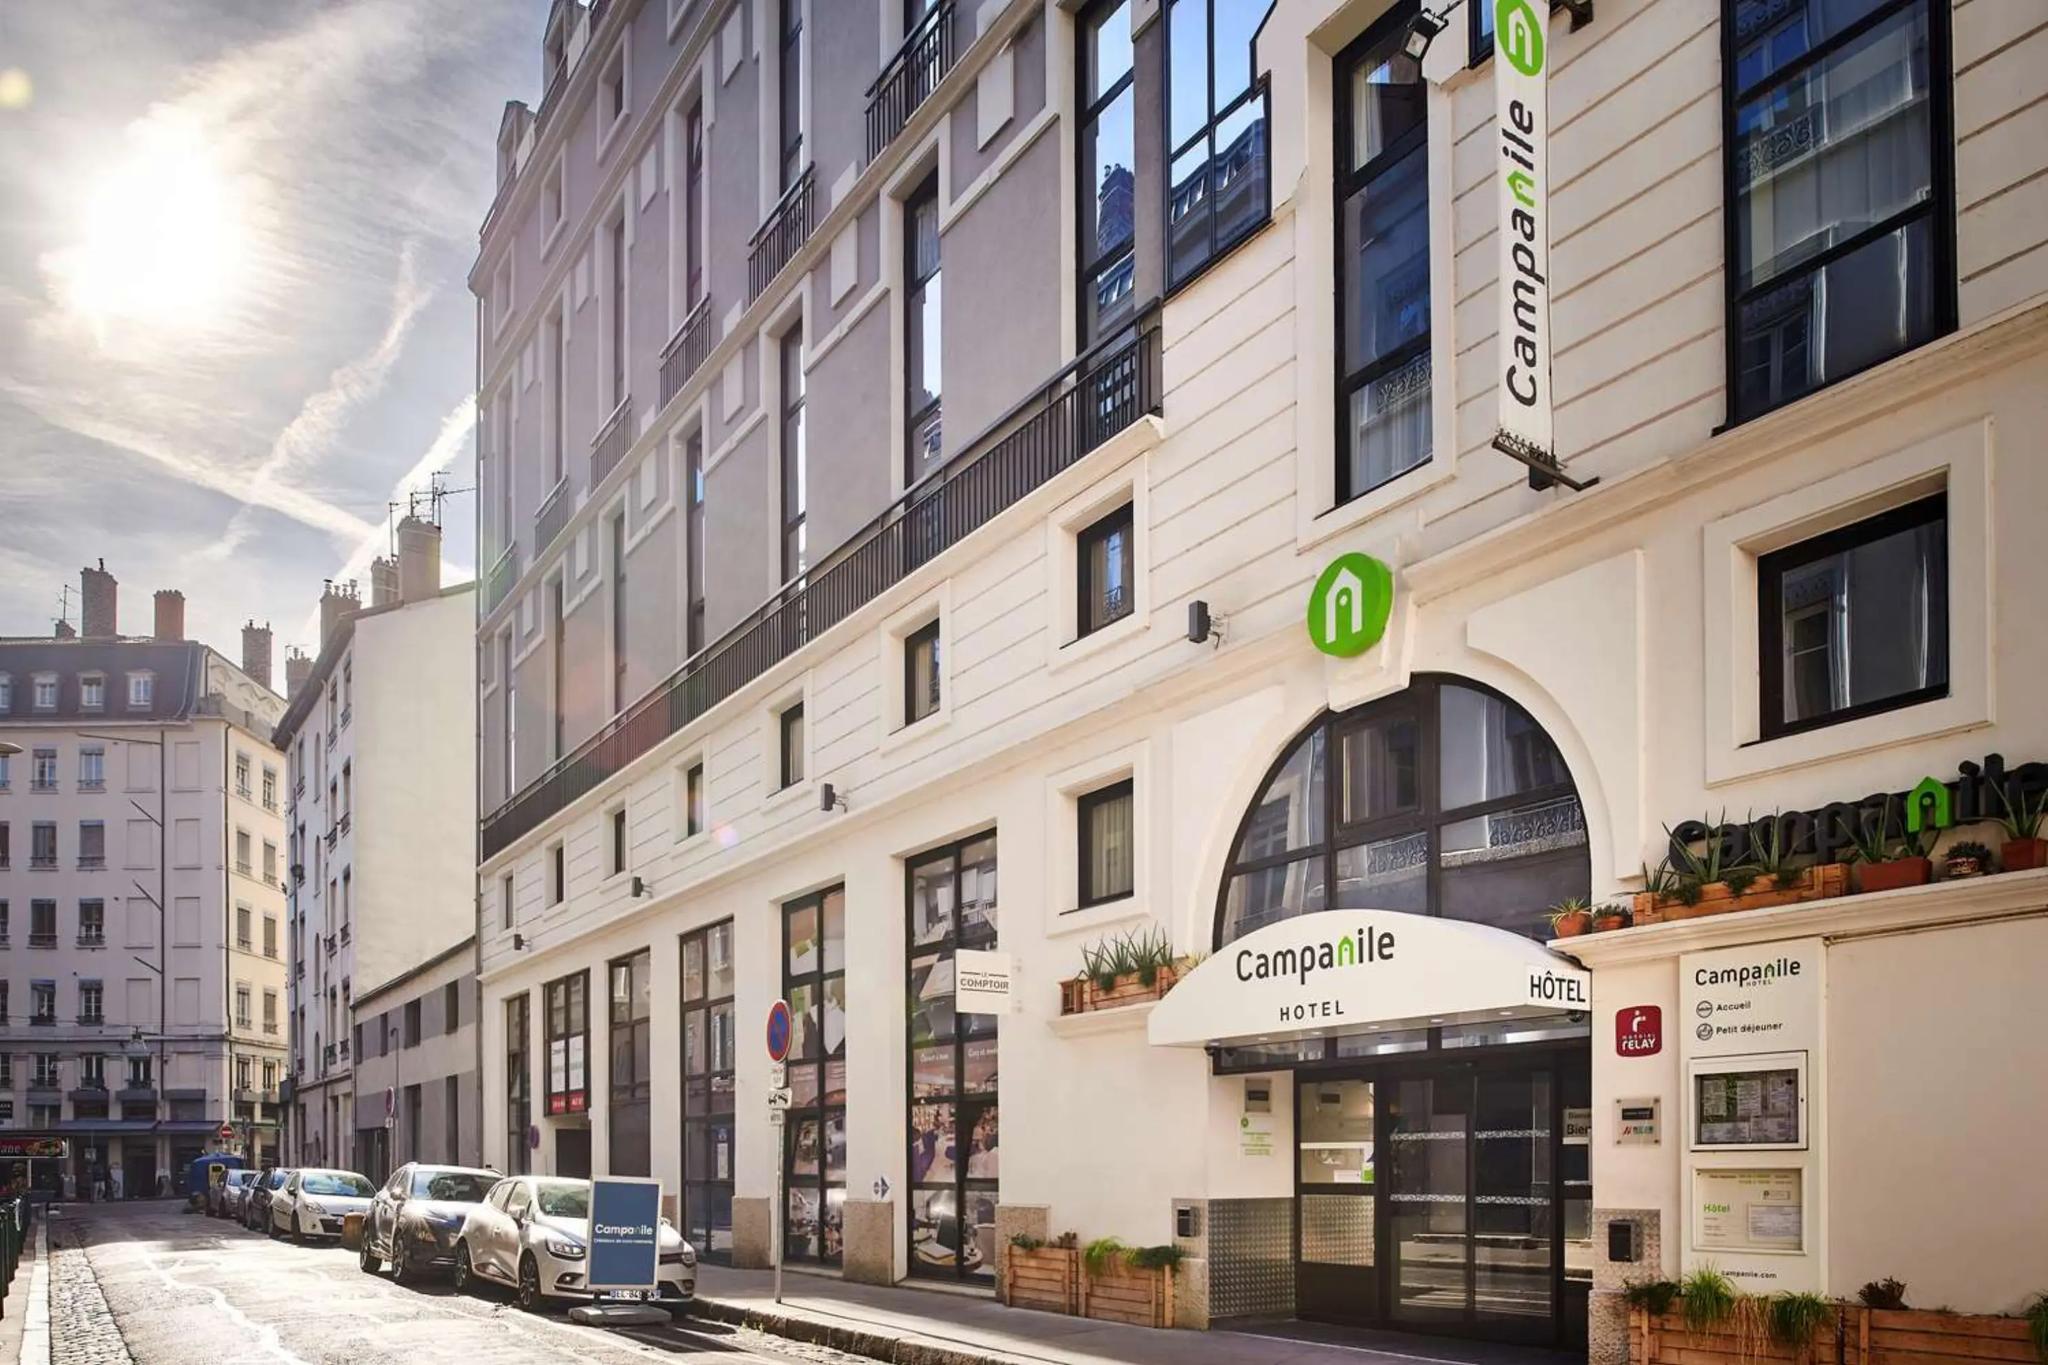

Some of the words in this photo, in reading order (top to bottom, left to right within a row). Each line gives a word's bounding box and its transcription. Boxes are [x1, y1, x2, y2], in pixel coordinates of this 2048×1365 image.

[1502, 99, 1545, 407] Campanile
[1668, 752, 2048, 873] Campanile
[1236, 925, 1395, 985] Campanile
[1695, 957, 1801, 987] Campanile
[960, 978, 1009, 989] COMPTOIR
[1530, 970, 1586, 1003] HÔTEL
[1280, 1000, 1345, 1021] HOTEL
[1716, 1000, 1752, 1012] Accueil
[1716, 1025, 1738, 1034] Petit
[1740, 1023, 1783, 1033] déjeuner
[1703, 1203, 1730, 1213] Hôtel
[594, 1223, 653, 1237] Campanile
